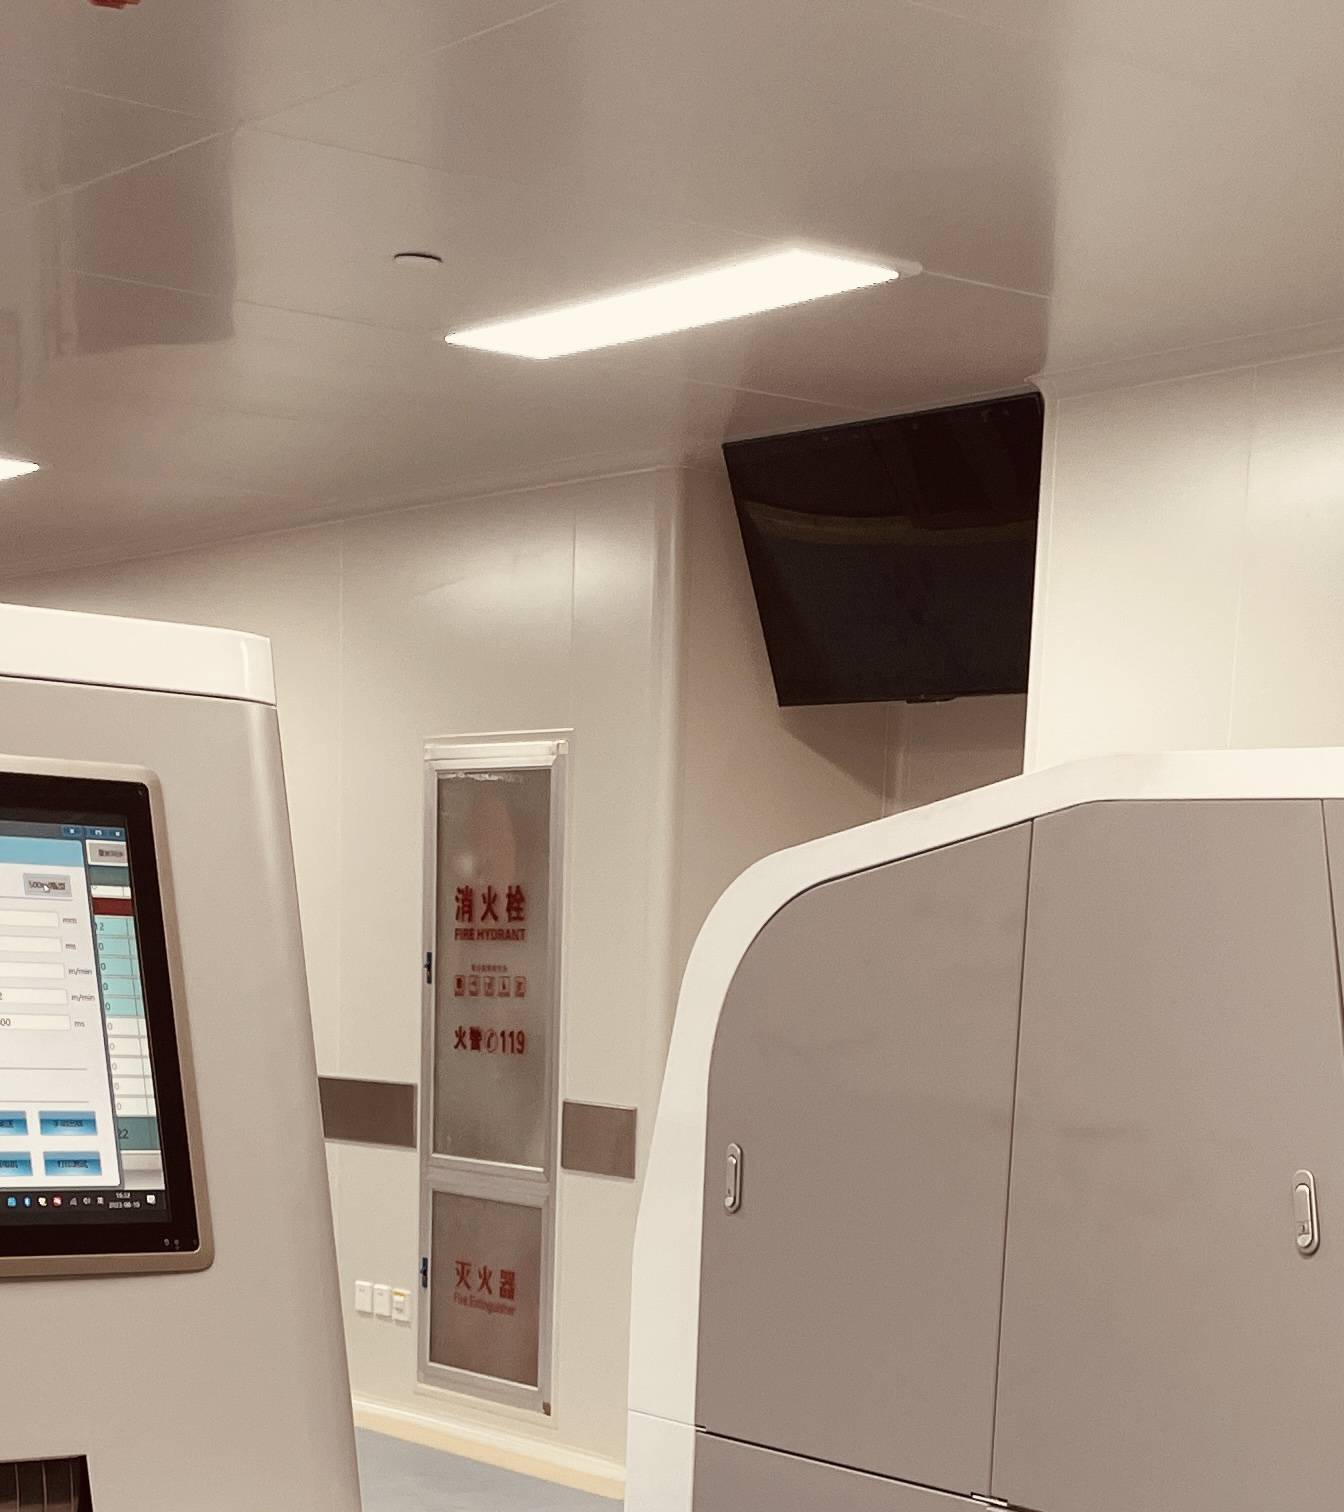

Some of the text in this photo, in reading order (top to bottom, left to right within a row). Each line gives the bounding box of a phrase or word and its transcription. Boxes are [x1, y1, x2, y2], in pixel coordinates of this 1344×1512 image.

[455, 885, 525, 922] 消火栓
[455, 928, 526, 941] FIRE HYDRANT
[454, 1025, 525, 1054] 火警 119
[455, 1260, 515, 1301] 灭火器
[455, 1292, 468, 1306] Fire
